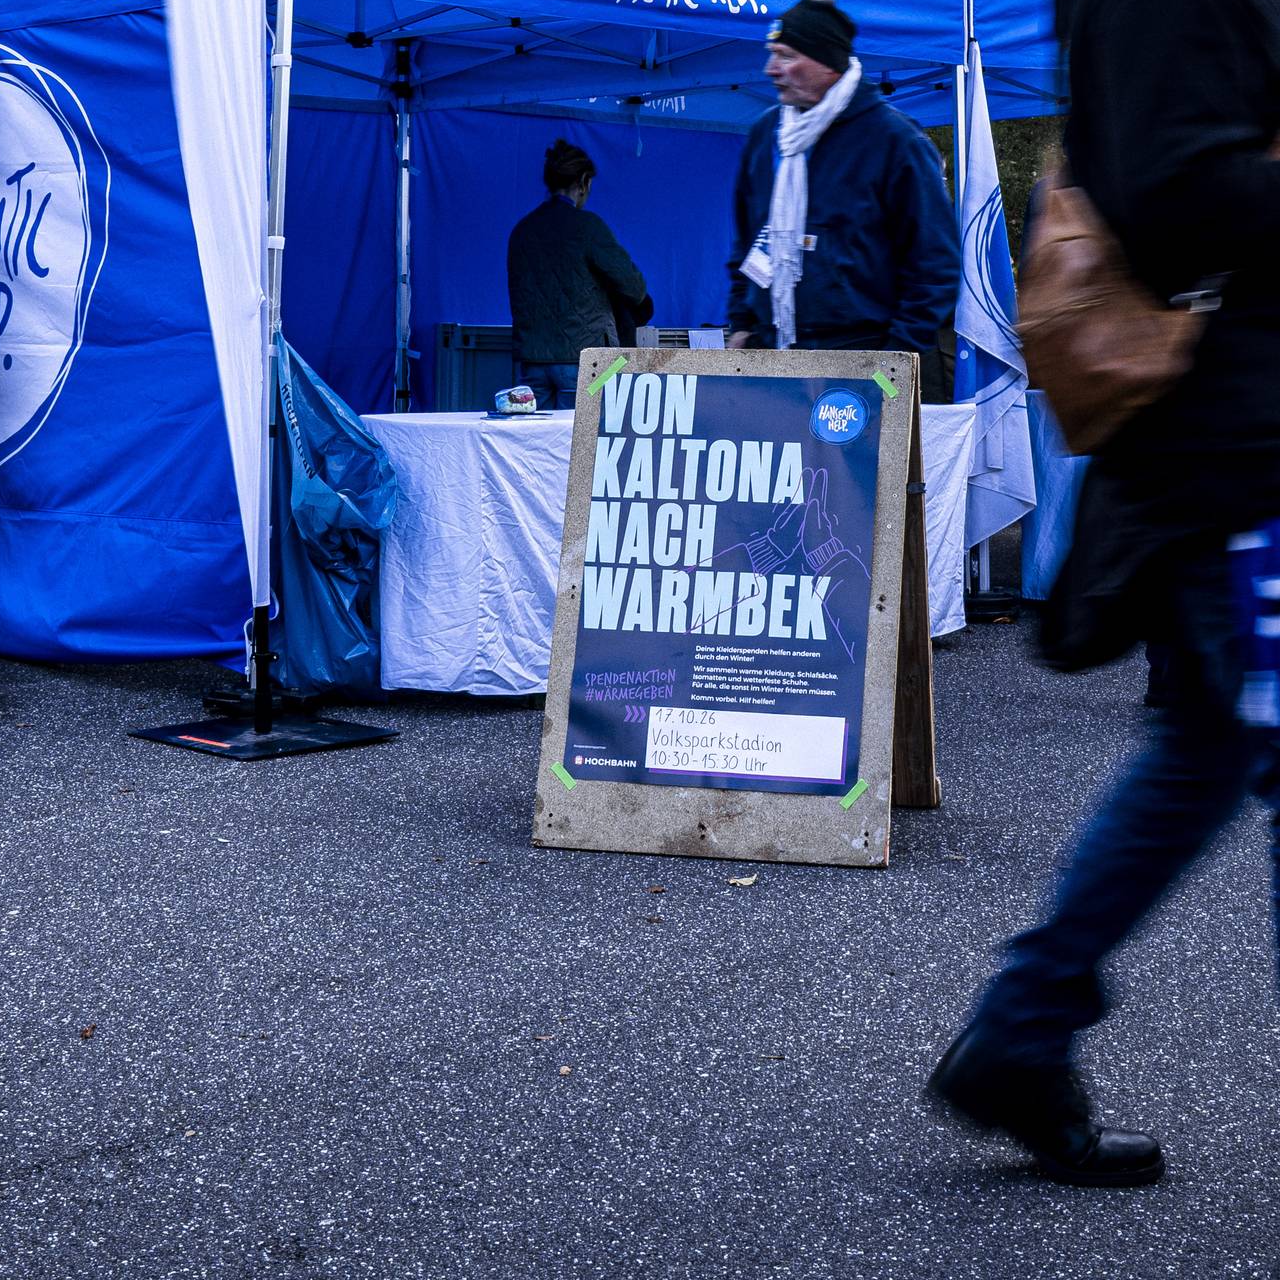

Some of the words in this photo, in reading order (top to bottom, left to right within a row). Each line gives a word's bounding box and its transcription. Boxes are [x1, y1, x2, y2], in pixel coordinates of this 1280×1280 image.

[602, 373, 697, 436] VON
[818, 404, 858, 421] HANSEATIC
[828, 419, 849, 432] HELP.
[590, 437, 805, 504] KALTONA
[583, 501, 717, 568] NACH
[583, 566, 831, 641] WARMBEK
[695, 645, 715, 653] Deine
[716, 646, 768, 656] Kleiderspenden
[792, 650, 821, 658] anderen
[695, 653, 715, 661] durch
[730, 655, 755, 663] Winter!
[585, 668, 676, 687] SPENDENAKTION
[706, 666, 738, 674] sammeln
[739, 668, 762, 676] warme
[742, 676, 781, 685] wetterfeste
[782, 678, 809, 686] Schuhe.
[585, 685, 674, 702] #WÄRMEGEBEN
[691, 694, 715, 702] Komm
[761, 685, 785, 693] Winter
[785, 686, 807, 694] frieren
[808, 688, 837, 696] müssen.
[655, 708, 716, 725] 17.10.26
[652, 728, 783, 756] Volksparkstadion
[584, 757, 637, 768] HOCHBAHN
[745, 758, 768, 772] Uhr
